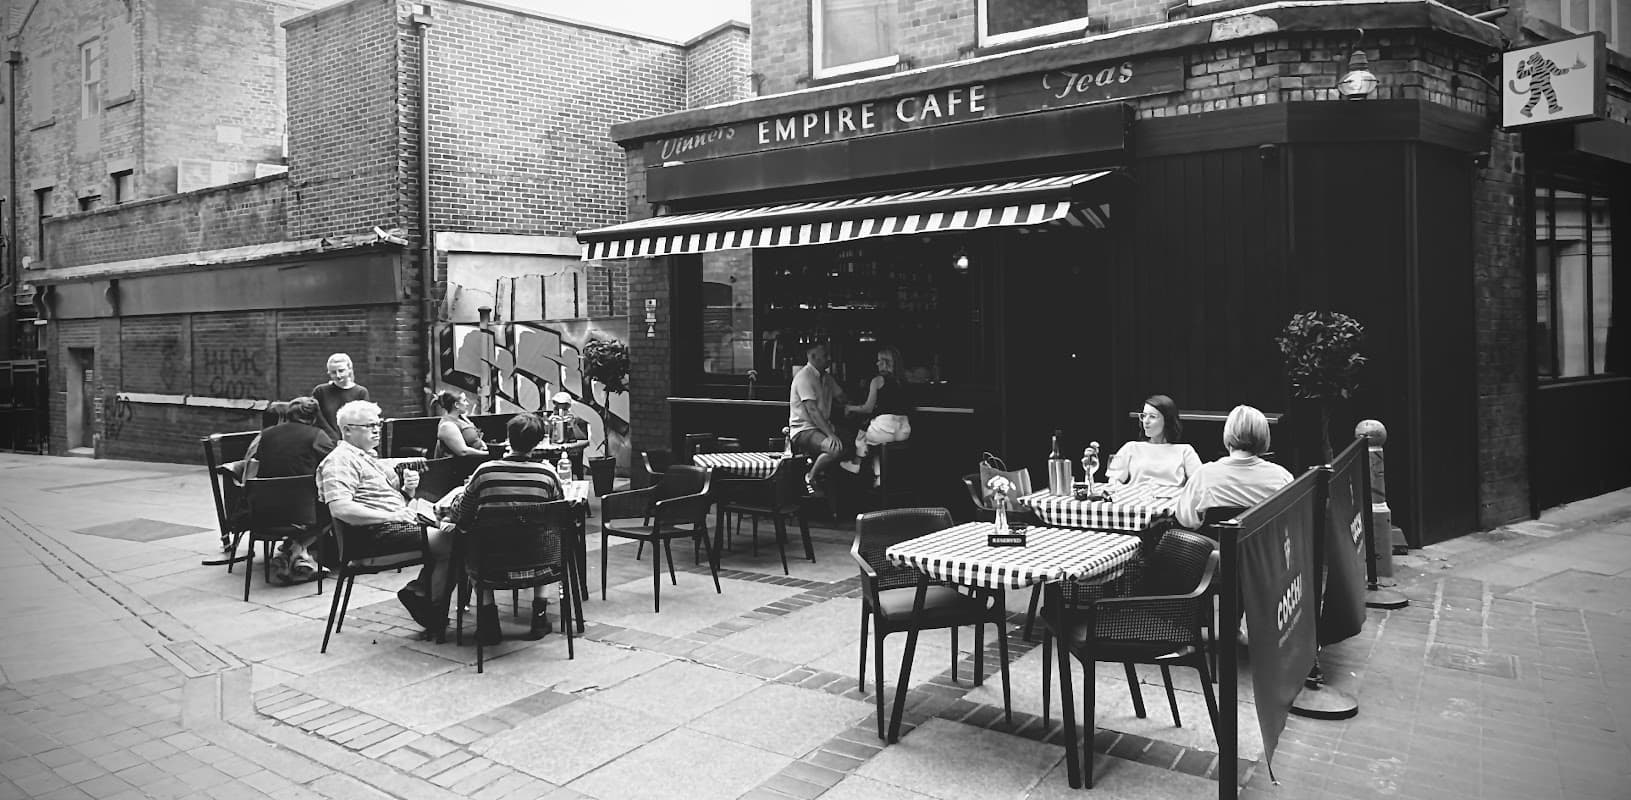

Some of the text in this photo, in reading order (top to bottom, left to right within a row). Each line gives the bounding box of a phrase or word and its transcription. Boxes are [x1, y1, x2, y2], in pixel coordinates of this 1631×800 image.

[1042, 62, 1133, 99] Teas
[758, 85, 985, 144] EMPIRE CAFE
[1277, 572, 1303, 631] COCCHI
